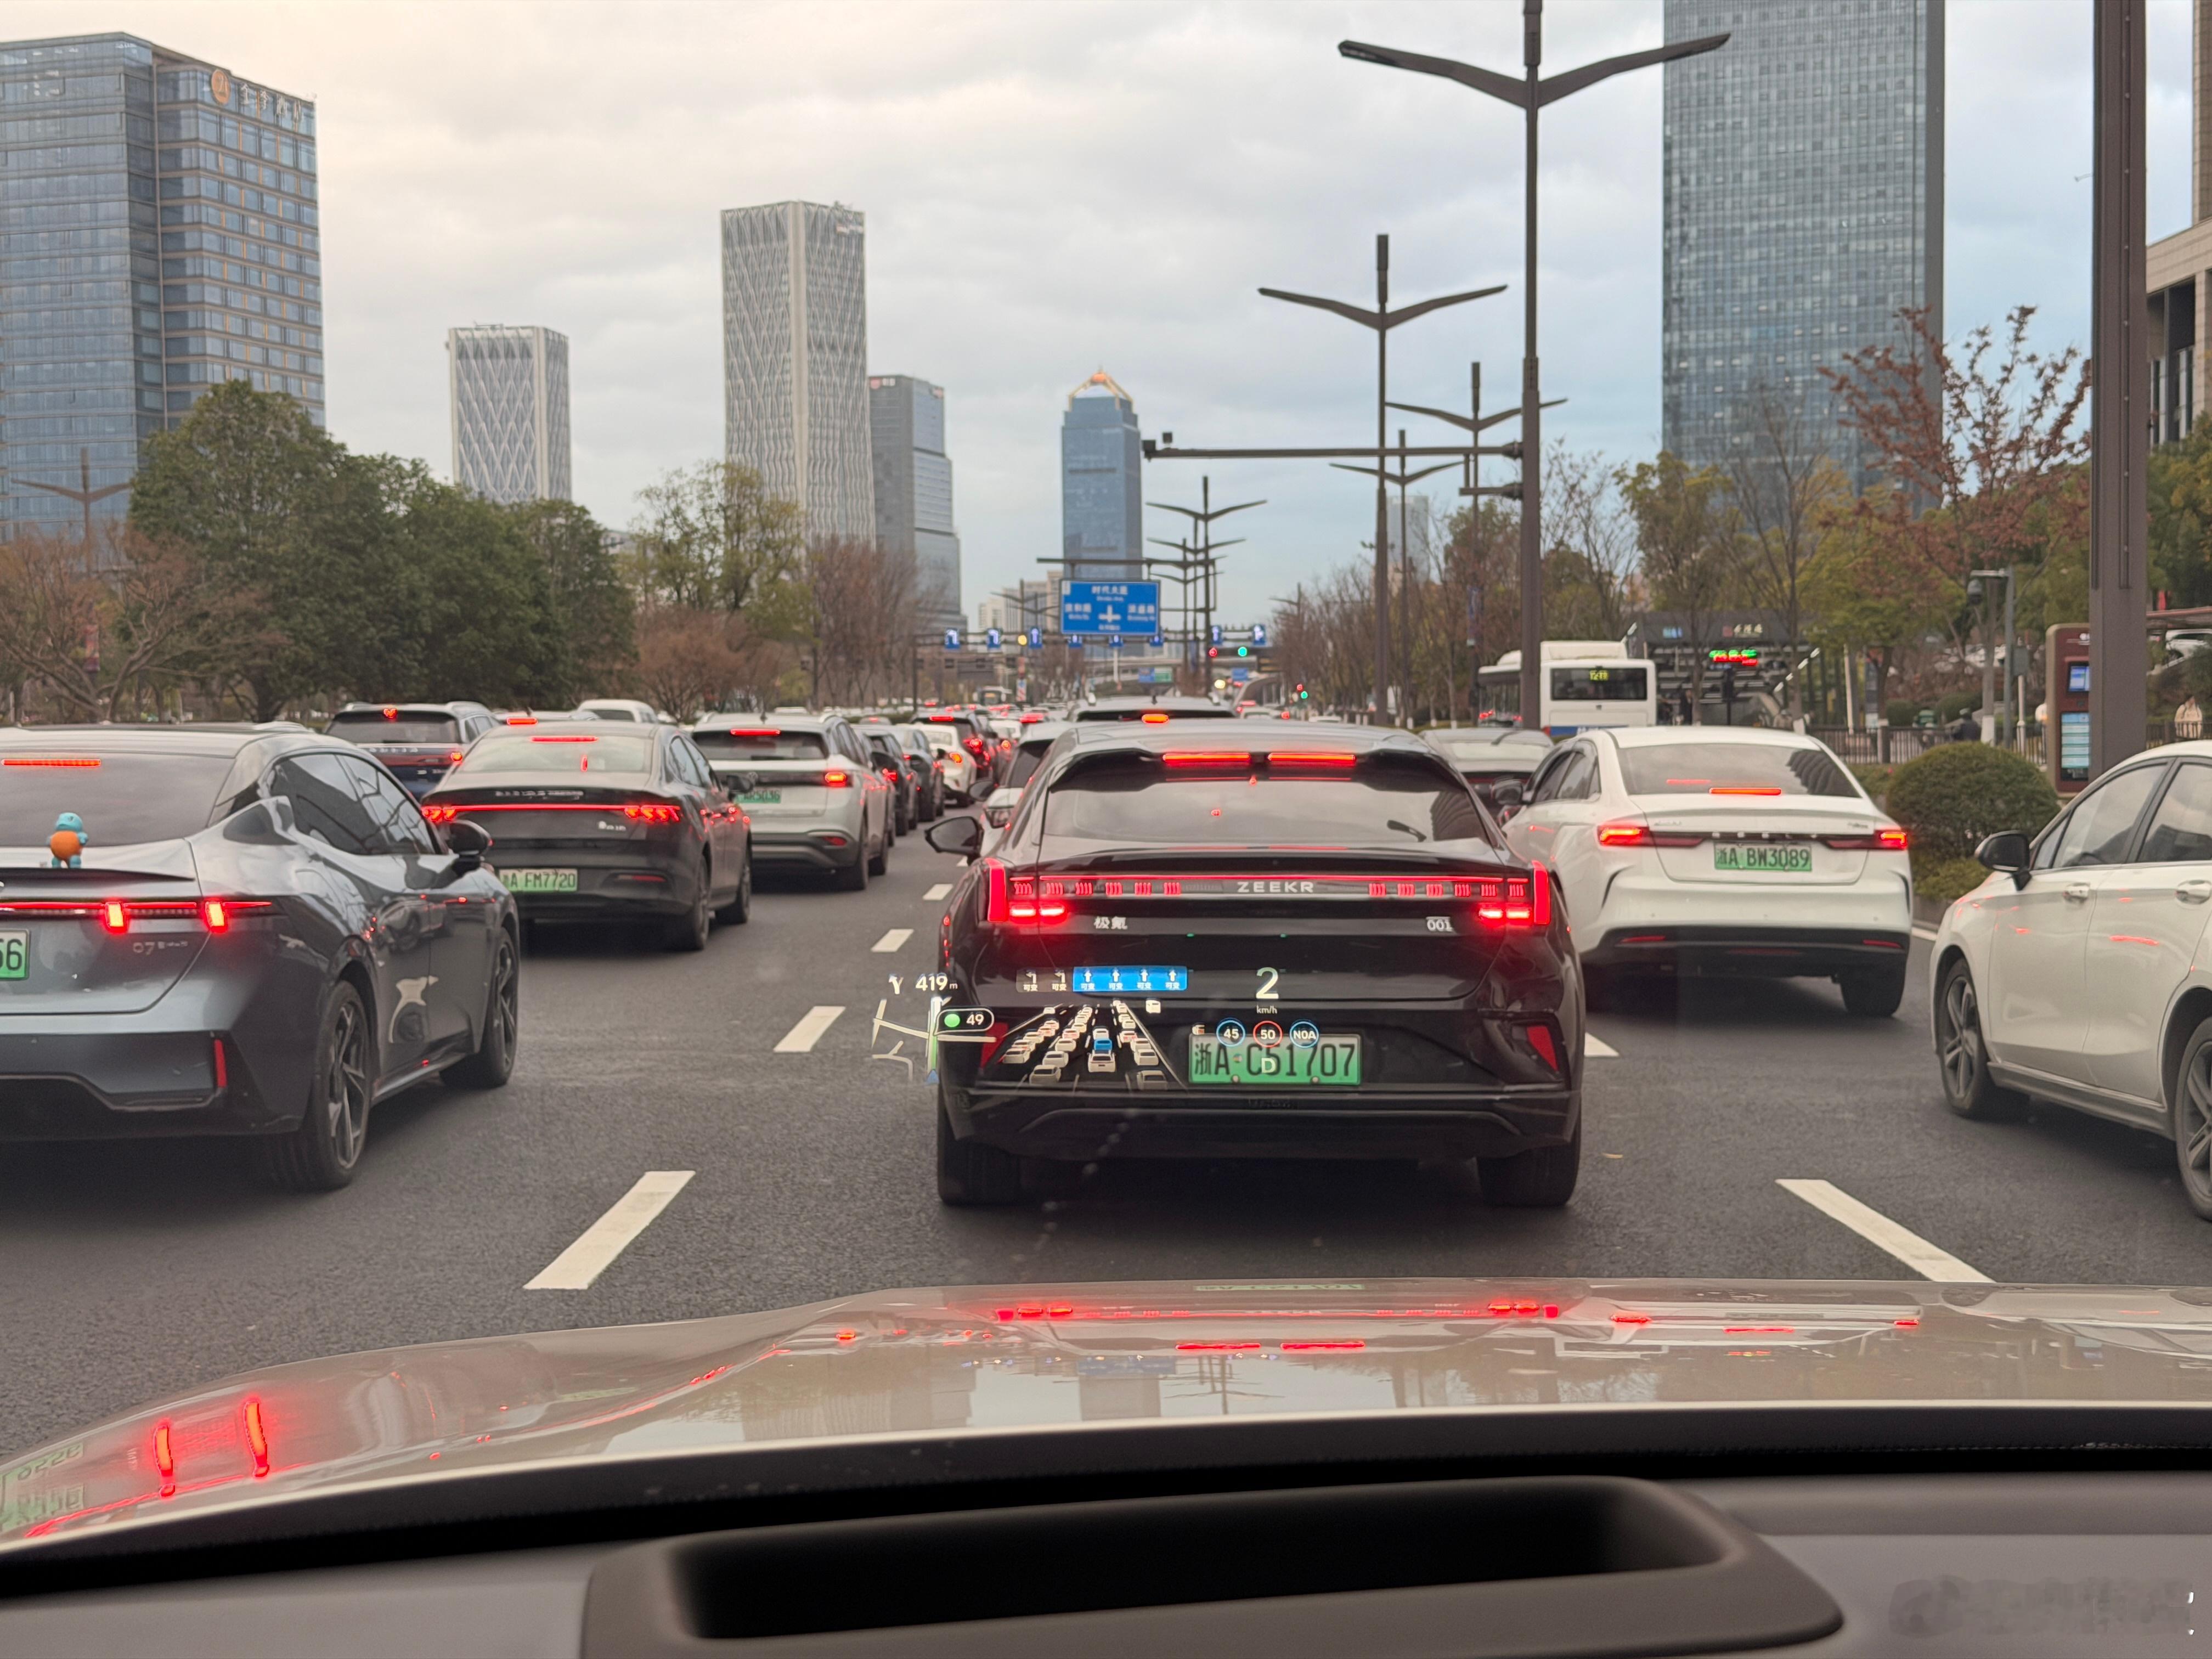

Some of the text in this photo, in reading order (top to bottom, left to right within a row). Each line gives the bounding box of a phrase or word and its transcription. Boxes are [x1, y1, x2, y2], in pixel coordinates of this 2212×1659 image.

[1746, 848, 1809, 868] BW3089
[1237, 881, 1314, 893] ZEEKR
[1427, 919, 1453, 932] 001
[0, 939, 22, 970] 6
[916, 974, 948, 991] 419
[1256, 967, 1279, 999] 2
[1256, 1005, 1277, 1014] km/h
[966, 1014, 984, 1025] 49
[1223, 1029, 1239, 1040] 45
[1260, 1029, 1276, 1040] 50
[1246, 1043, 1355, 1076] C51707
[1261, 1058, 1276, 1073] D
